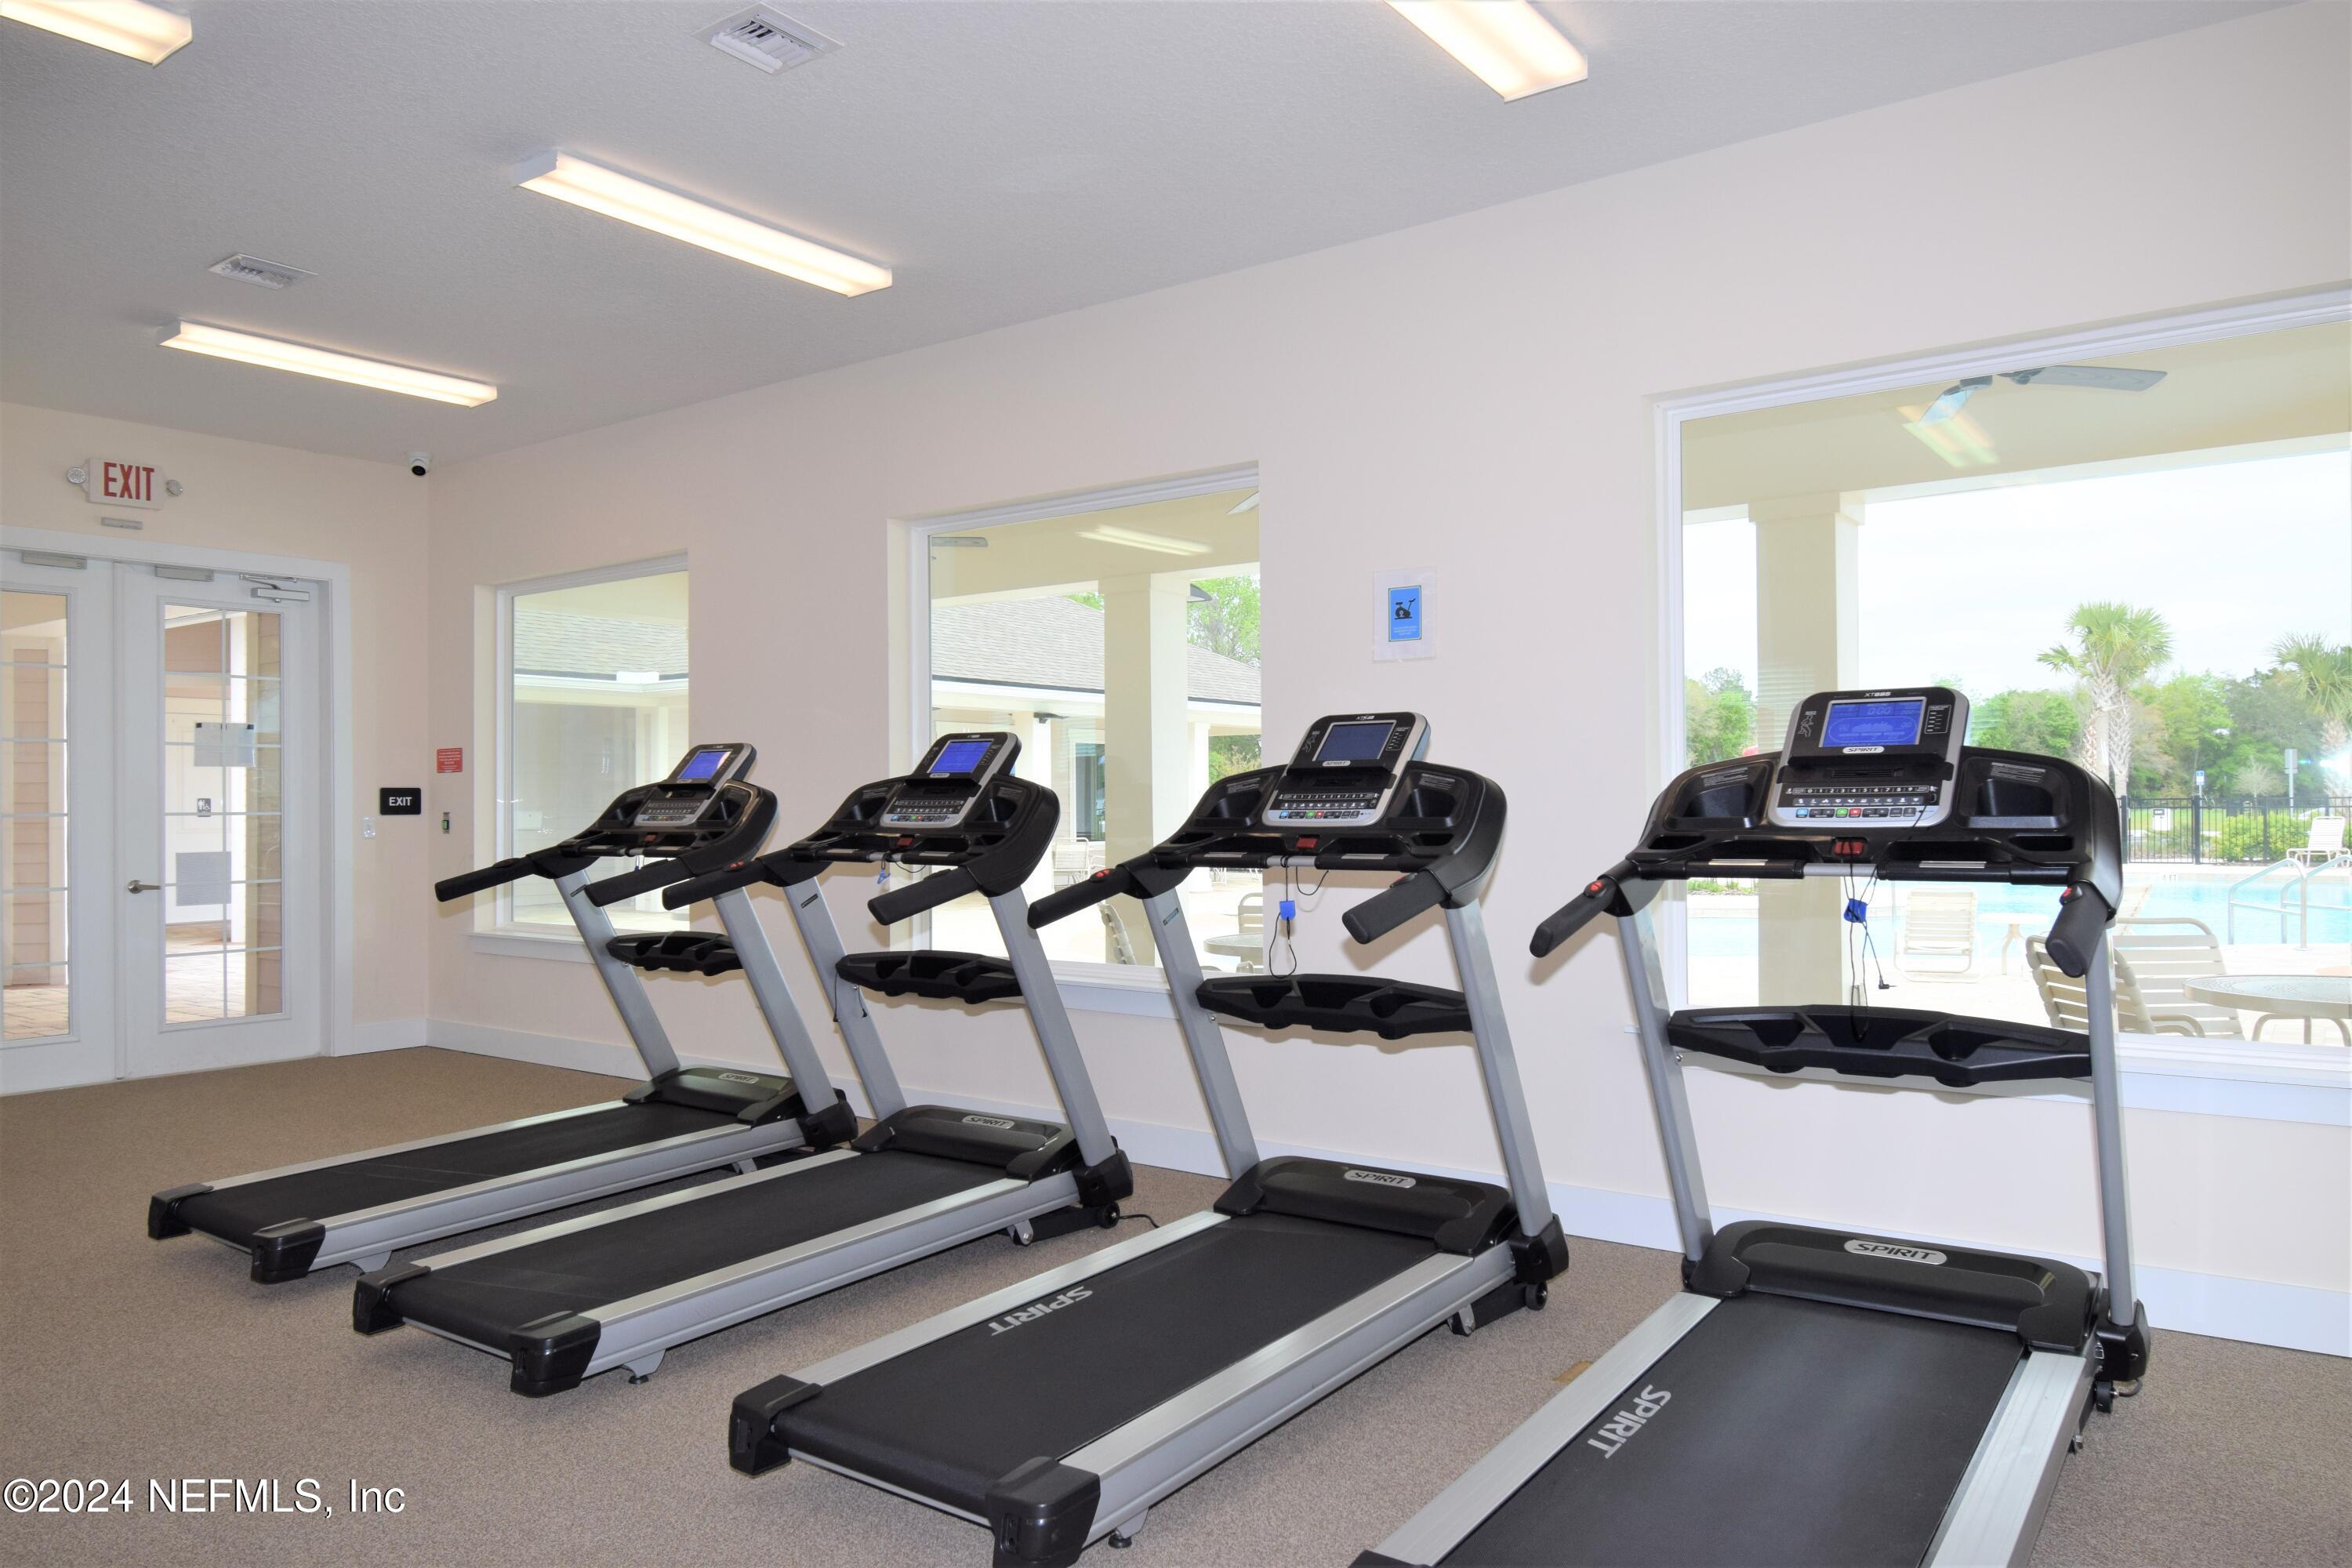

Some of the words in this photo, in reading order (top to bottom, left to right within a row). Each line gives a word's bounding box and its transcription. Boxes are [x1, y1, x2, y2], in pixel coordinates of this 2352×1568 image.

[103, 462, 155, 502] EXIT
[389, 797, 412, 806] EXIT
[965, 1116, 1009, 1127] SPIRIT
[1351, 1172, 1408, 1184] SPIRIT
[1853, 1243, 1937, 1260] SPIRIT
[988, 1286, 1093, 1337] SPIRIT
[1587, 1384, 1671, 1459] SPIRIT
